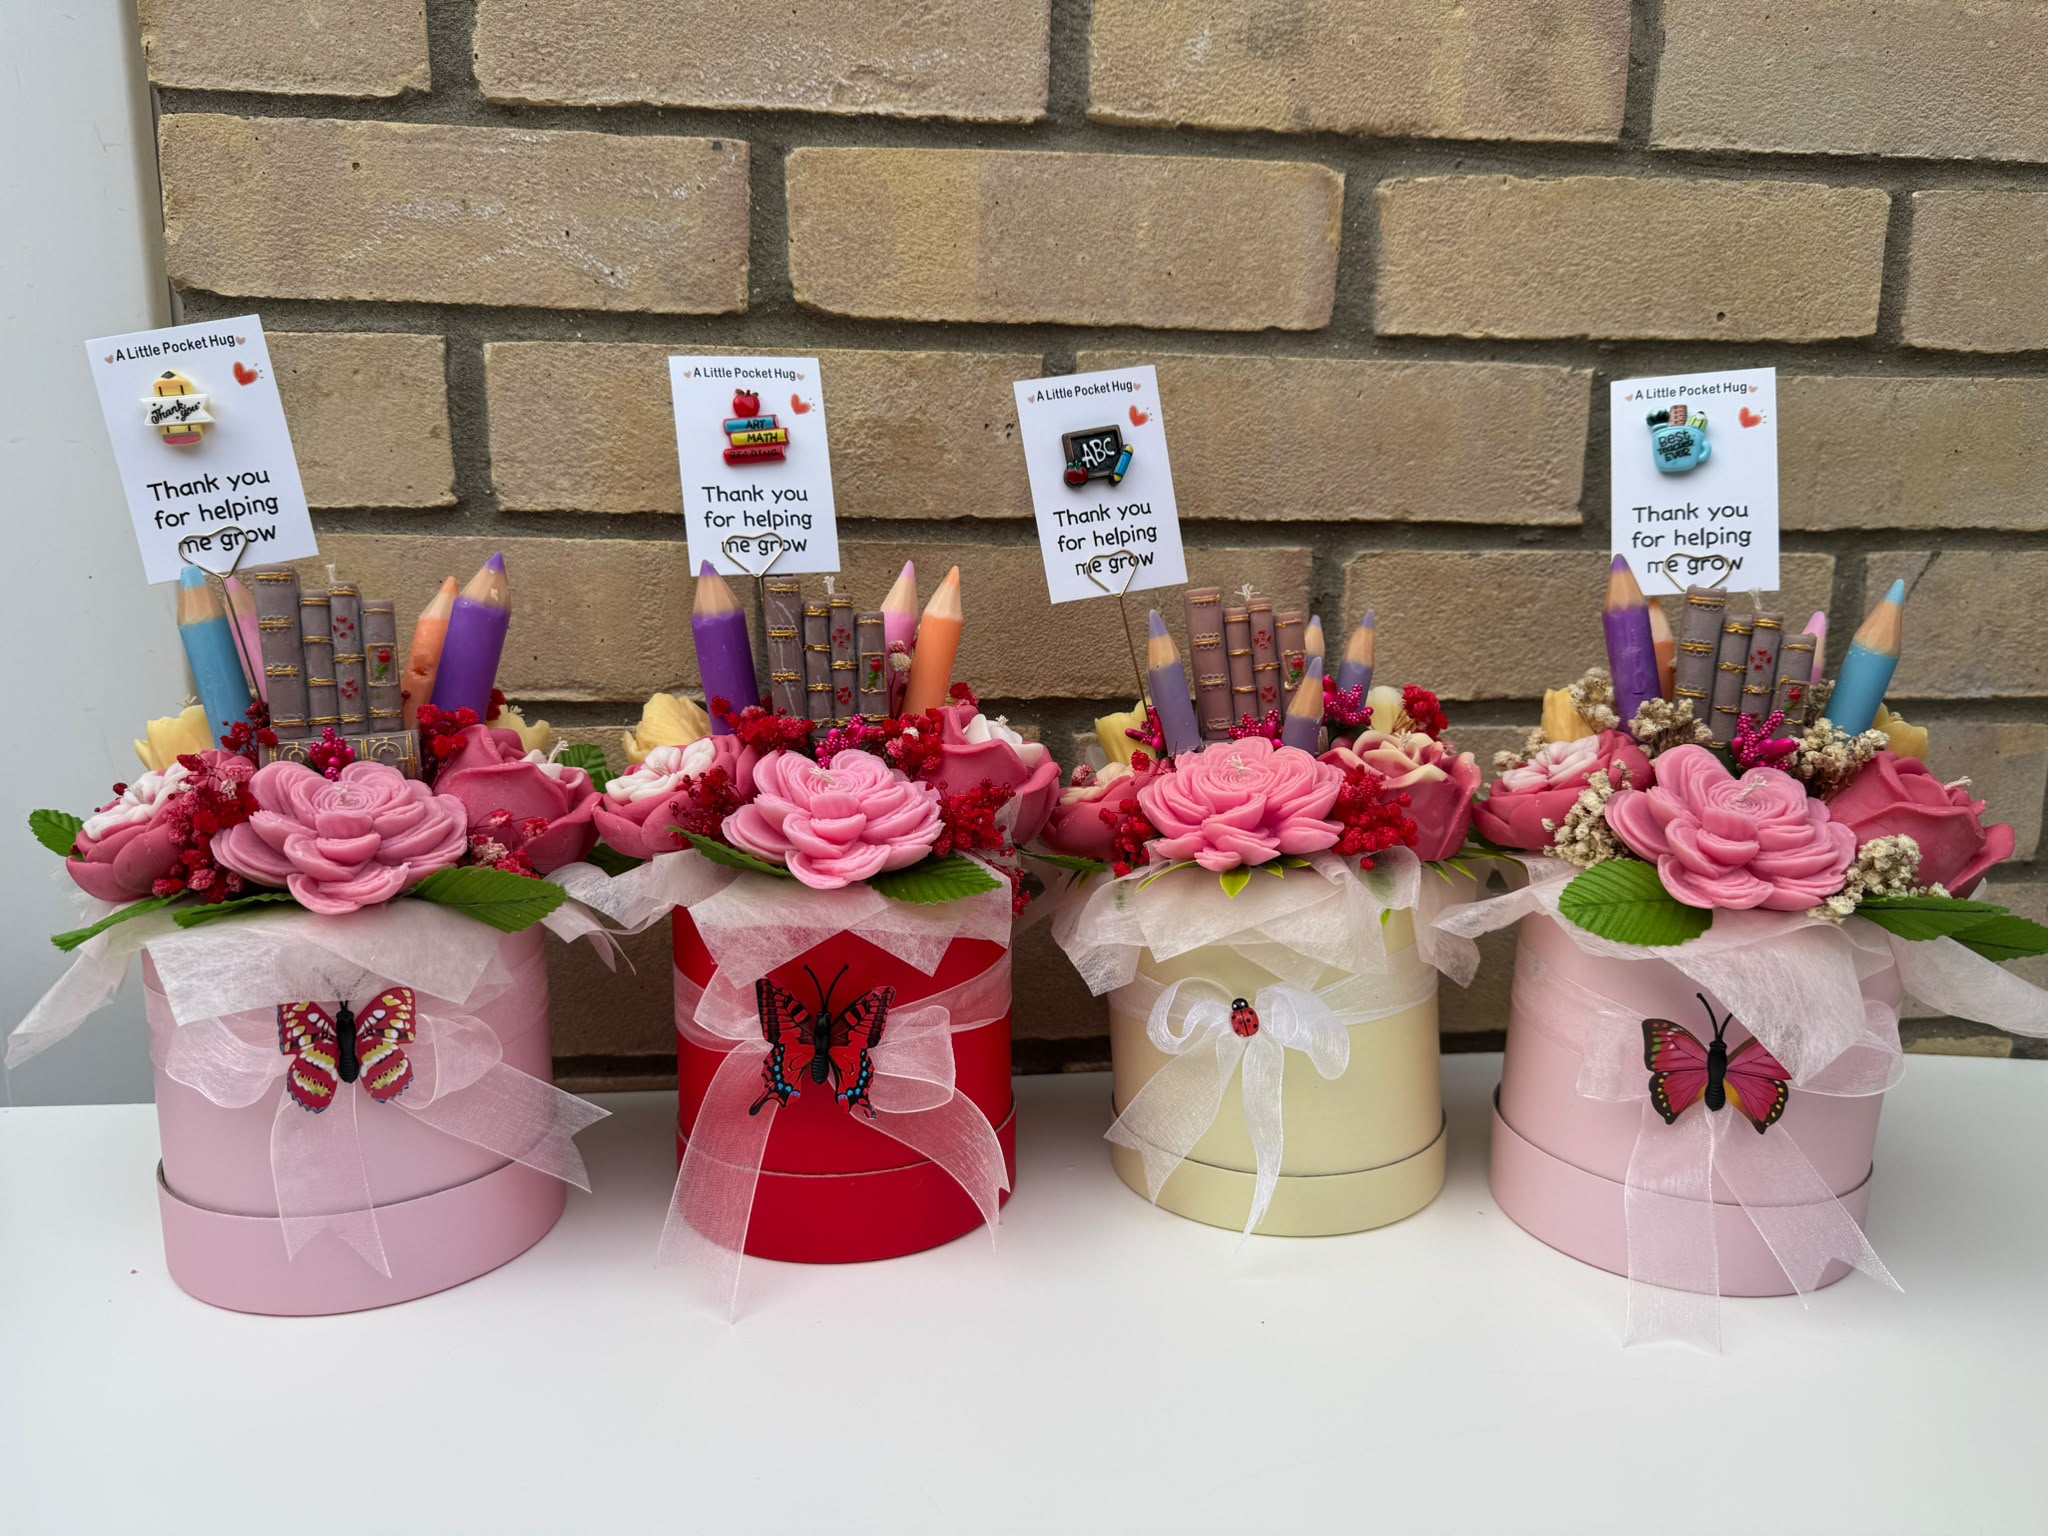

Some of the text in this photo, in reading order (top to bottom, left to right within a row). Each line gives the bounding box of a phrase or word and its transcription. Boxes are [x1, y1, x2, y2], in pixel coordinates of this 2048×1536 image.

[115, 334, 236, 361] A Little Pocket Hug
[693, 367, 796, 381] A Little Pocket Hug
[1037, 381, 1133, 402] A Little Pocket Hug
[1635, 383, 1747, 400] A Little Pocket Hug
[151, 400, 185, 425] Thank
[181, 402, 200, 422] you
[746, 419, 766, 430] ART
[747, 432, 778, 443] MATH
[730, 448, 779, 459] READING
[1081, 437, 1115, 468] ABC
[147, 470, 270, 501] Thank you
[702, 485, 807, 504] Thank you
[154, 496, 278, 529] for helping
[704, 510, 812, 530] for helping
[1053, 502, 1151, 527] Thank you
[1632, 503, 1748, 523] Thank you
[181, 525, 276, 553] me grow
[721, 539, 807, 556] me grow
[1057, 525, 1157, 552] for helping
[1632, 527, 1752, 548] for helping
[1075, 551, 1154, 576] me grow
[1647, 556, 1743, 575] me grow
